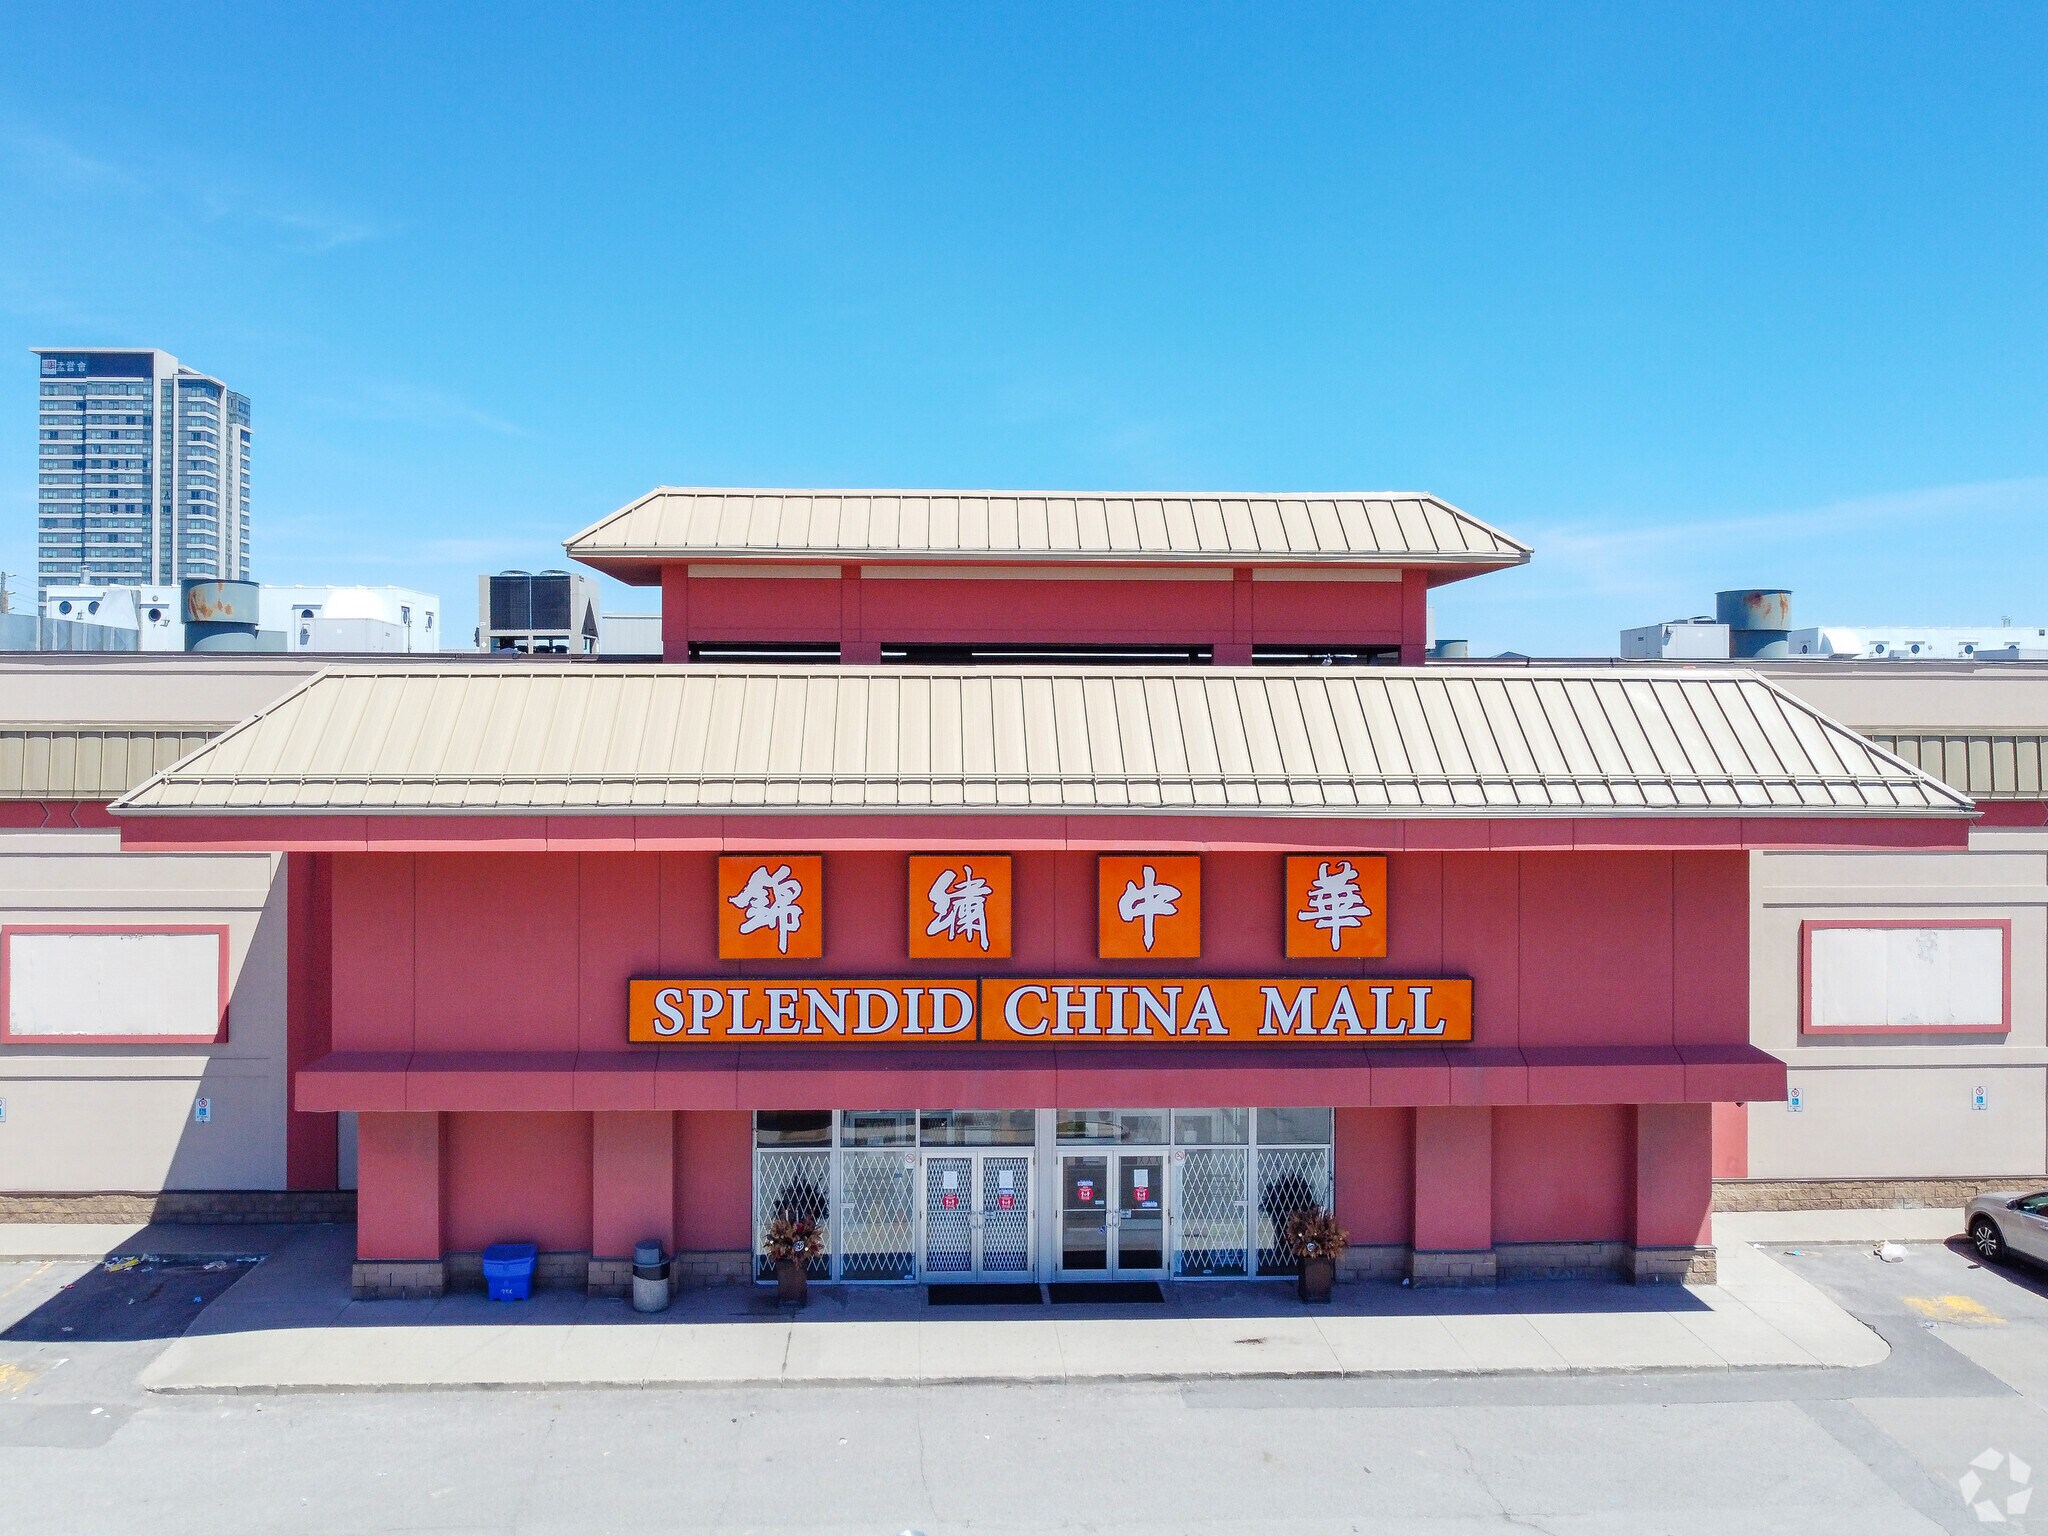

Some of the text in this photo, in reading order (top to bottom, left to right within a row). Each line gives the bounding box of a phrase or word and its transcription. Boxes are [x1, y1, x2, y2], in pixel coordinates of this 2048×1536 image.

[653, 985, 1446, 1035] SPLENDID CHINA MALL
